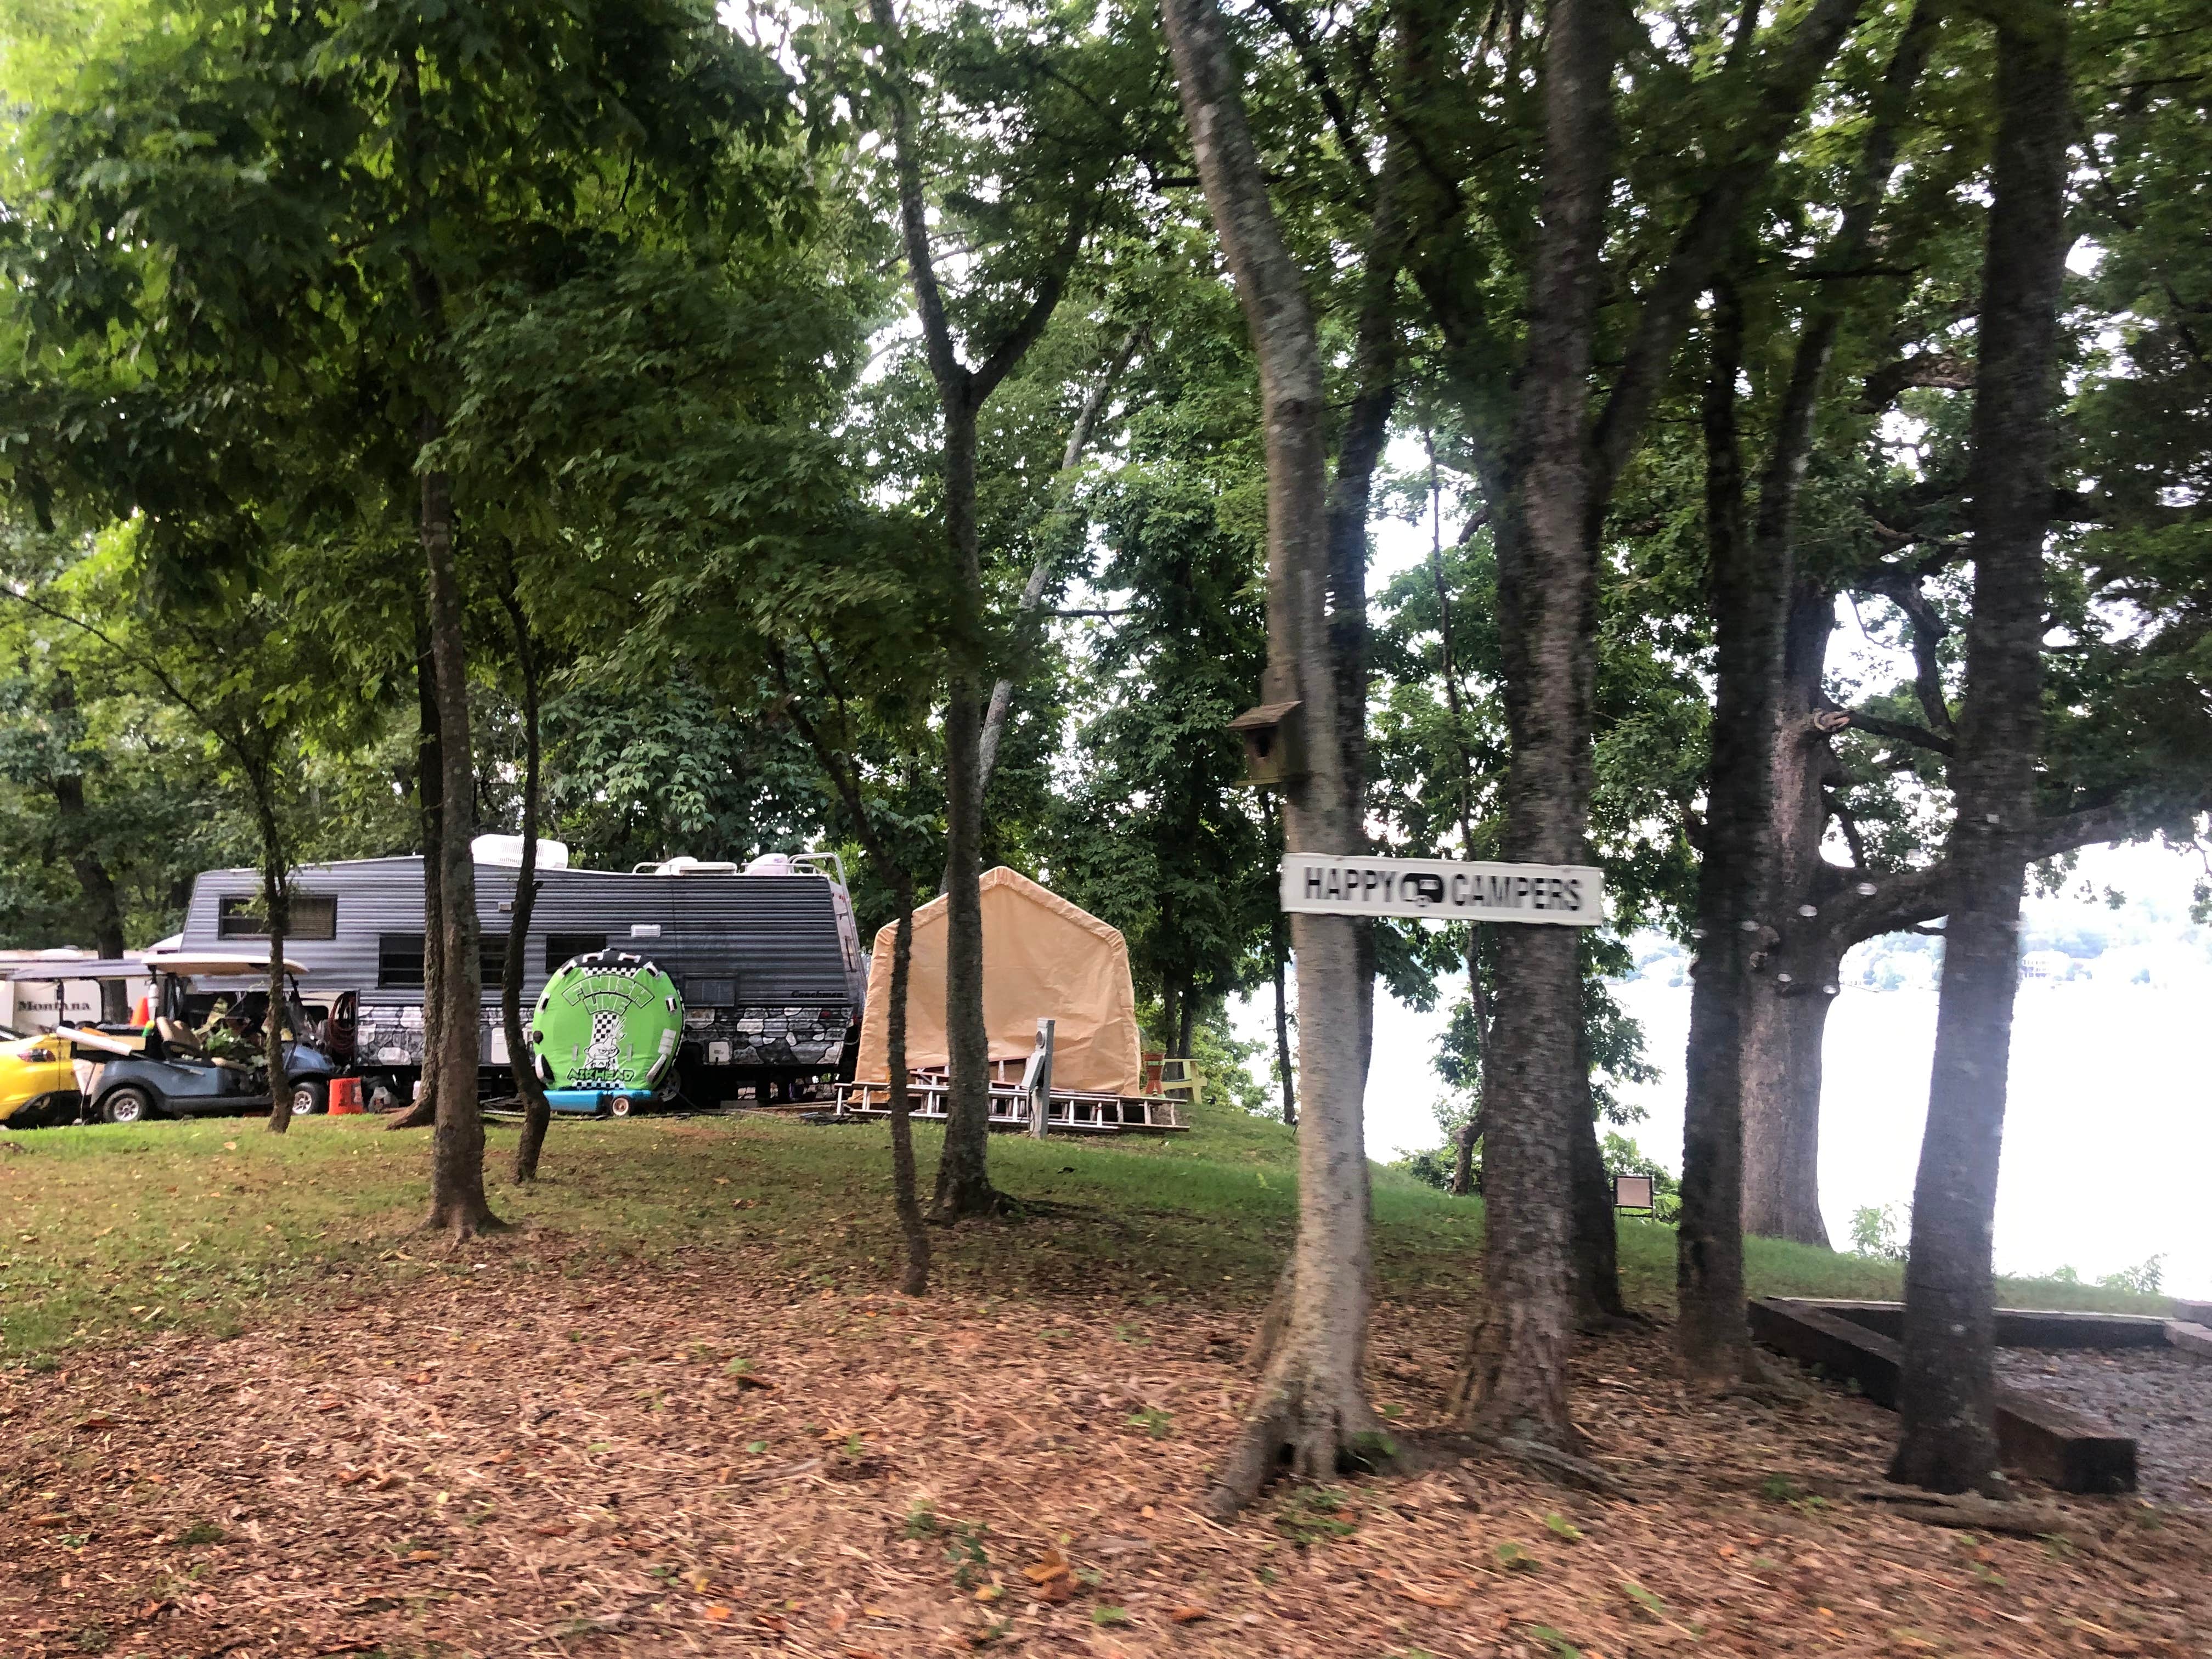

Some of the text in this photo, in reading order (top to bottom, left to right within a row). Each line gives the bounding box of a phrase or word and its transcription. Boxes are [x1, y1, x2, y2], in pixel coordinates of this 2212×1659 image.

[1304, 866, 1583, 911] HAPPY CAMPERS
[562, 974, 654, 1008] FINISH
[583, 993, 631, 1016] LINE
[567, 1068, 635, 1081] AIRHEAD
